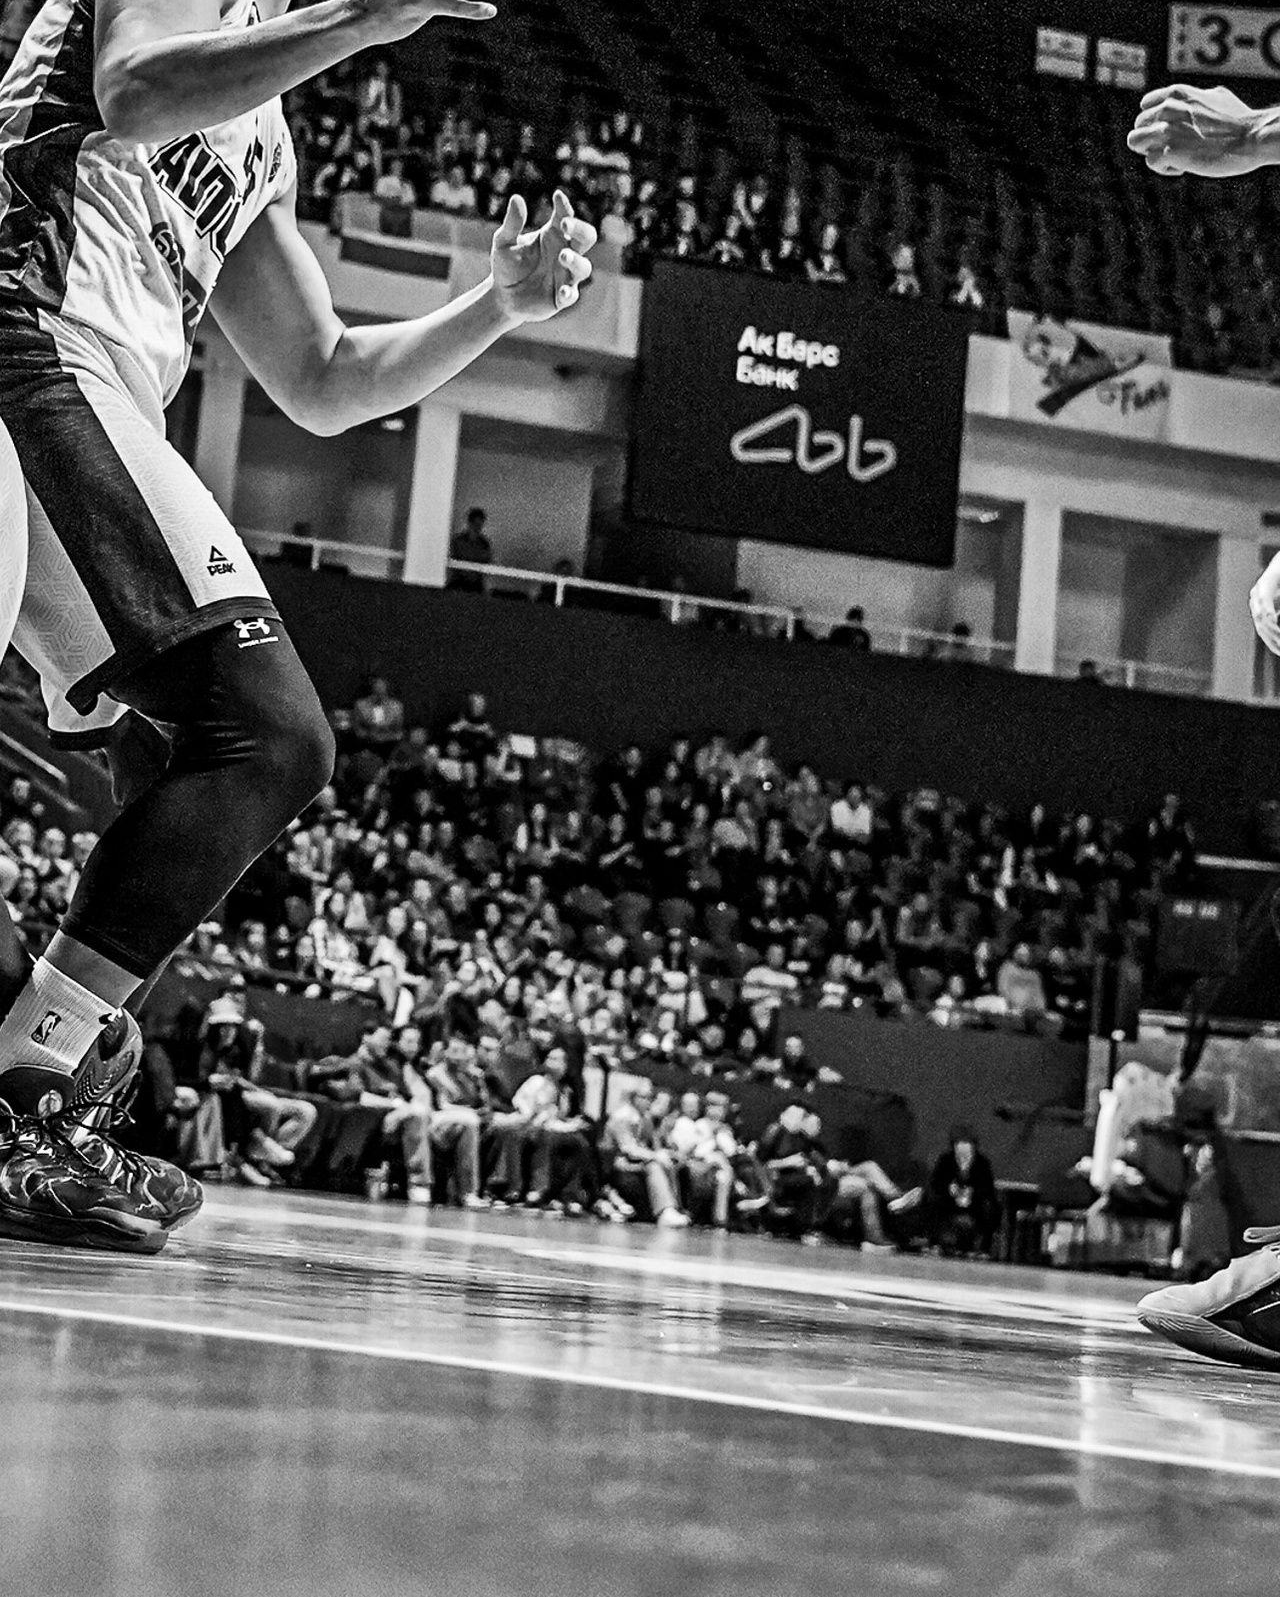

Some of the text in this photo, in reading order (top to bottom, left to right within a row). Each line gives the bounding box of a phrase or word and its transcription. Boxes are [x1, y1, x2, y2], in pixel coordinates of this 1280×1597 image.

[737, 325, 840, 369] Ак Барс
[736, 355, 800, 392] Банк
[206, 563, 237, 576] PEAK
